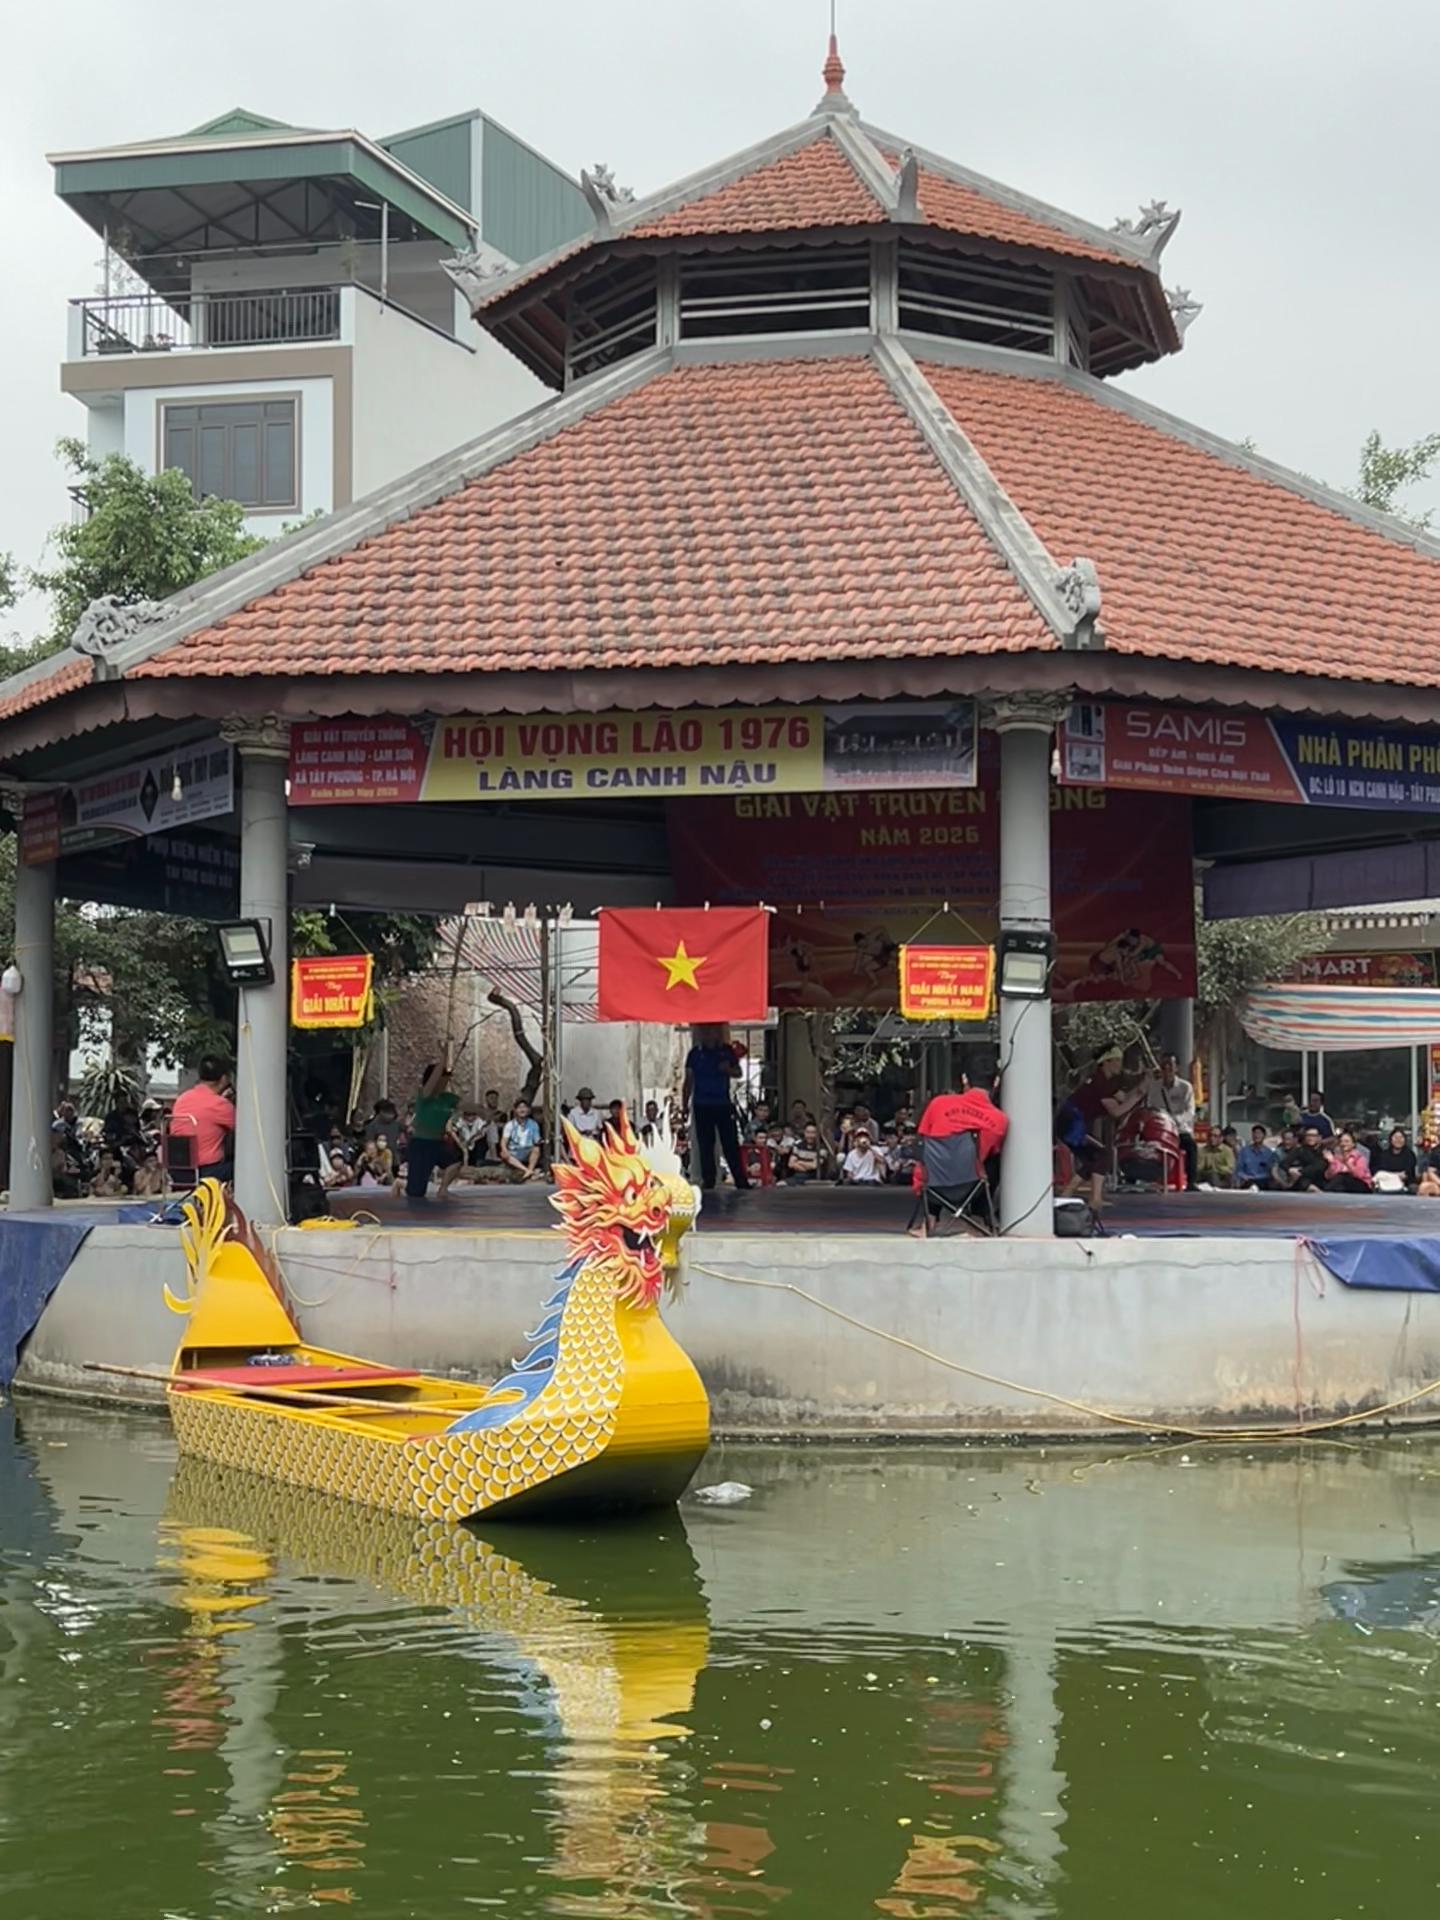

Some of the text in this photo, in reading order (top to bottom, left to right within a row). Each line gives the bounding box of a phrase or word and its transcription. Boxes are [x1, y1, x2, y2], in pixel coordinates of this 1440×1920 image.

[443, 715, 811, 764] HỘI VỌNG LÃO 1976
[1126, 711, 1247, 748] SAMIS
[1347, 735, 1404, 772] PHÂN
[480, 759, 777, 792] LÀNG CANH NẬU
[919, 826, 980, 847] 2026
[1301, 958, 1372, 977] MART
[303, 992, 323, 1014] GIẢI
[324, 991, 350, 1013] NHẤT
